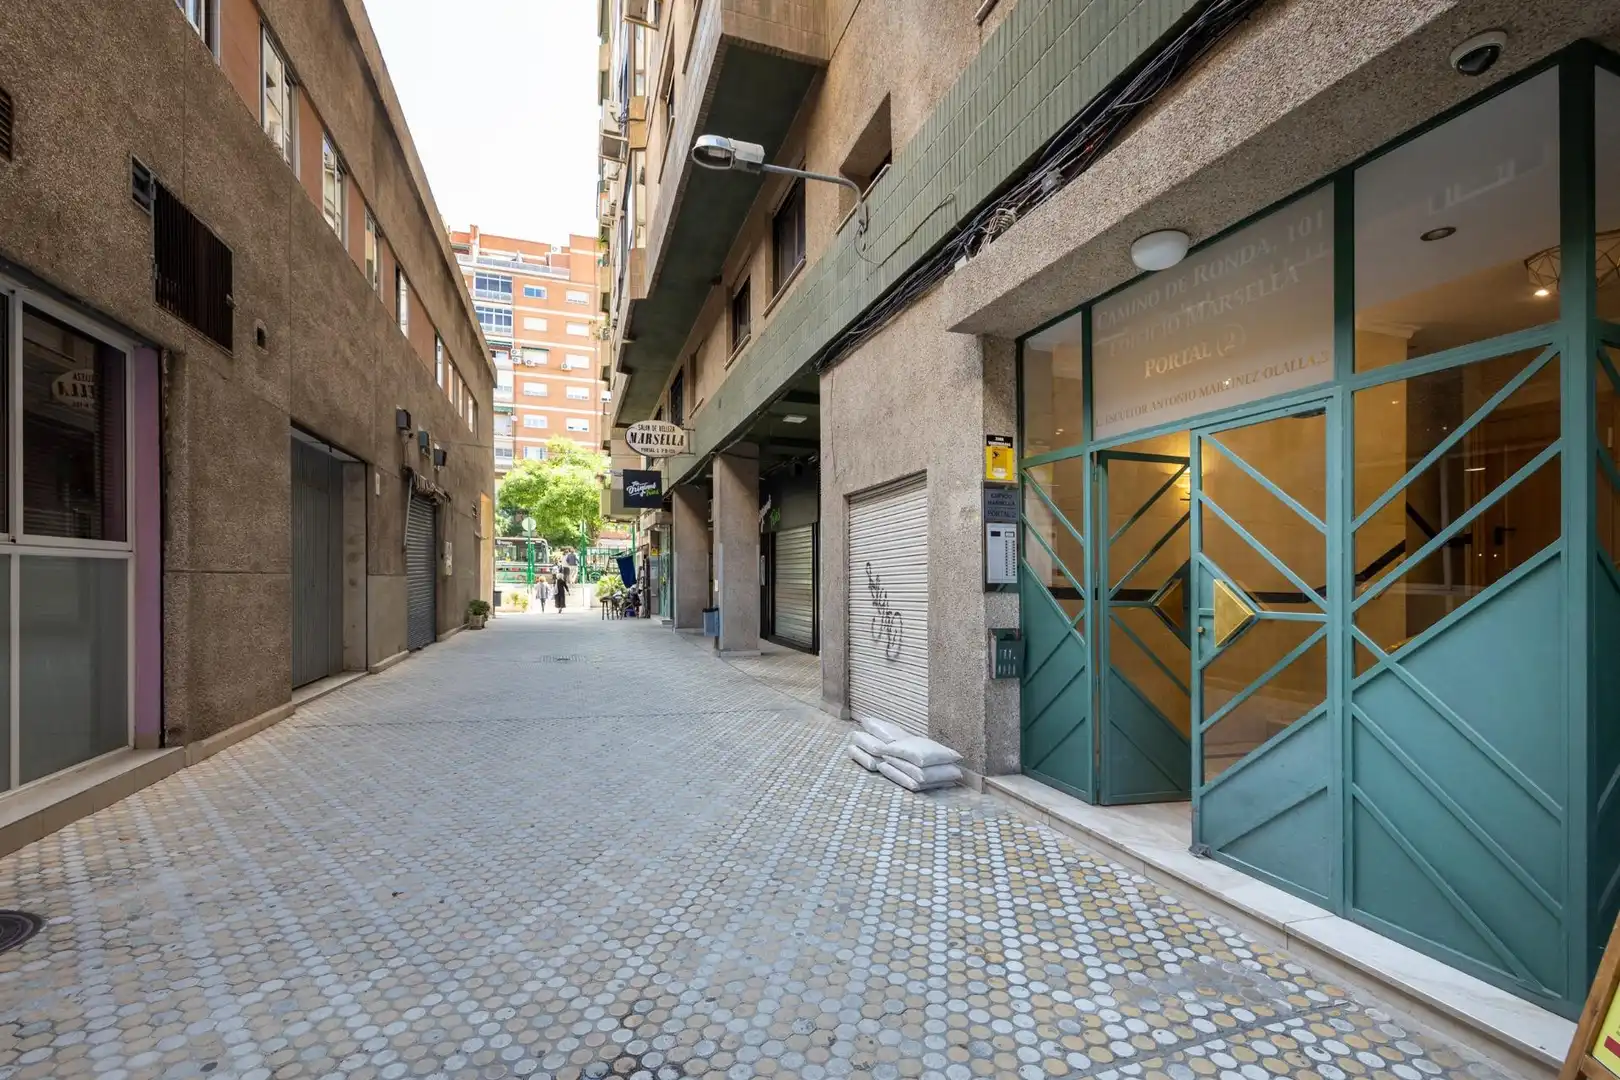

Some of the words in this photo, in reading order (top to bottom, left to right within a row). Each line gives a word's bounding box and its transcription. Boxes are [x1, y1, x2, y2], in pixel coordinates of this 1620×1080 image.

[1096, 289, 1160, 332] CAMINO
[1288, 210, 1324, 243] 101
[1186, 265, 1300, 327] MARSELLA
[1143, 341, 1212, 379] PORTAL
[1151, 390, 1196, 412] ANTONIO
[629, 432, 684, 447] MARSELLA
